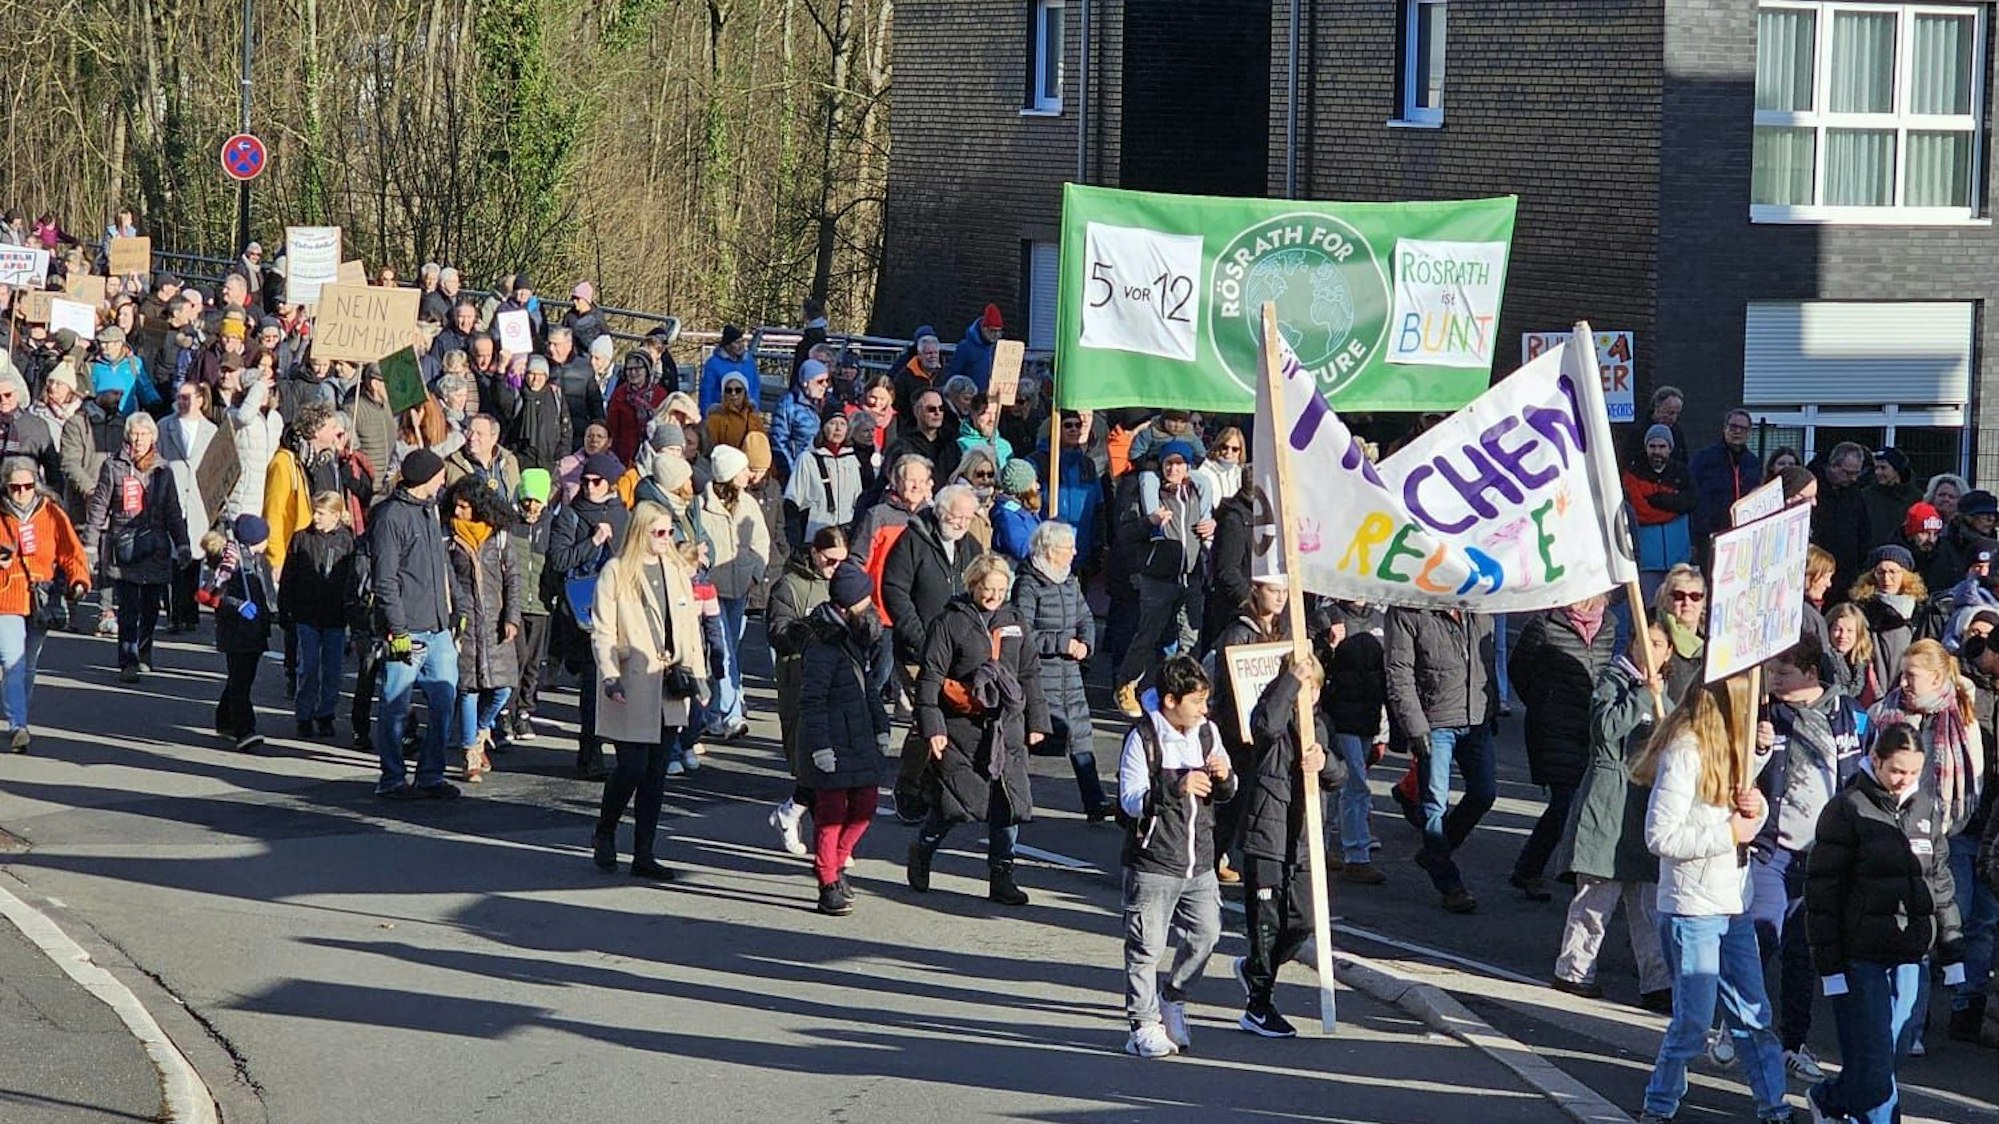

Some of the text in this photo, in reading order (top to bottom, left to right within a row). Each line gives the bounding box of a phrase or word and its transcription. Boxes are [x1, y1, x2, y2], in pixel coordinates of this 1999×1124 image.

[1217, 226, 1354, 317] RÖSRATH FOR
[1401, 252, 1490, 285] RÖSRATH
[336, 295, 389, 321] NEIN
[1090, 262, 1193, 322] 5 VOR 12
[1441, 290, 1456, 305] ist
[322, 322, 369, 351] ZUM
[1398, 311, 1493, 353] BUNT
[1310, 338, 1367, 384] TURE
[1236, 655, 1282, 679] FASCHIS
